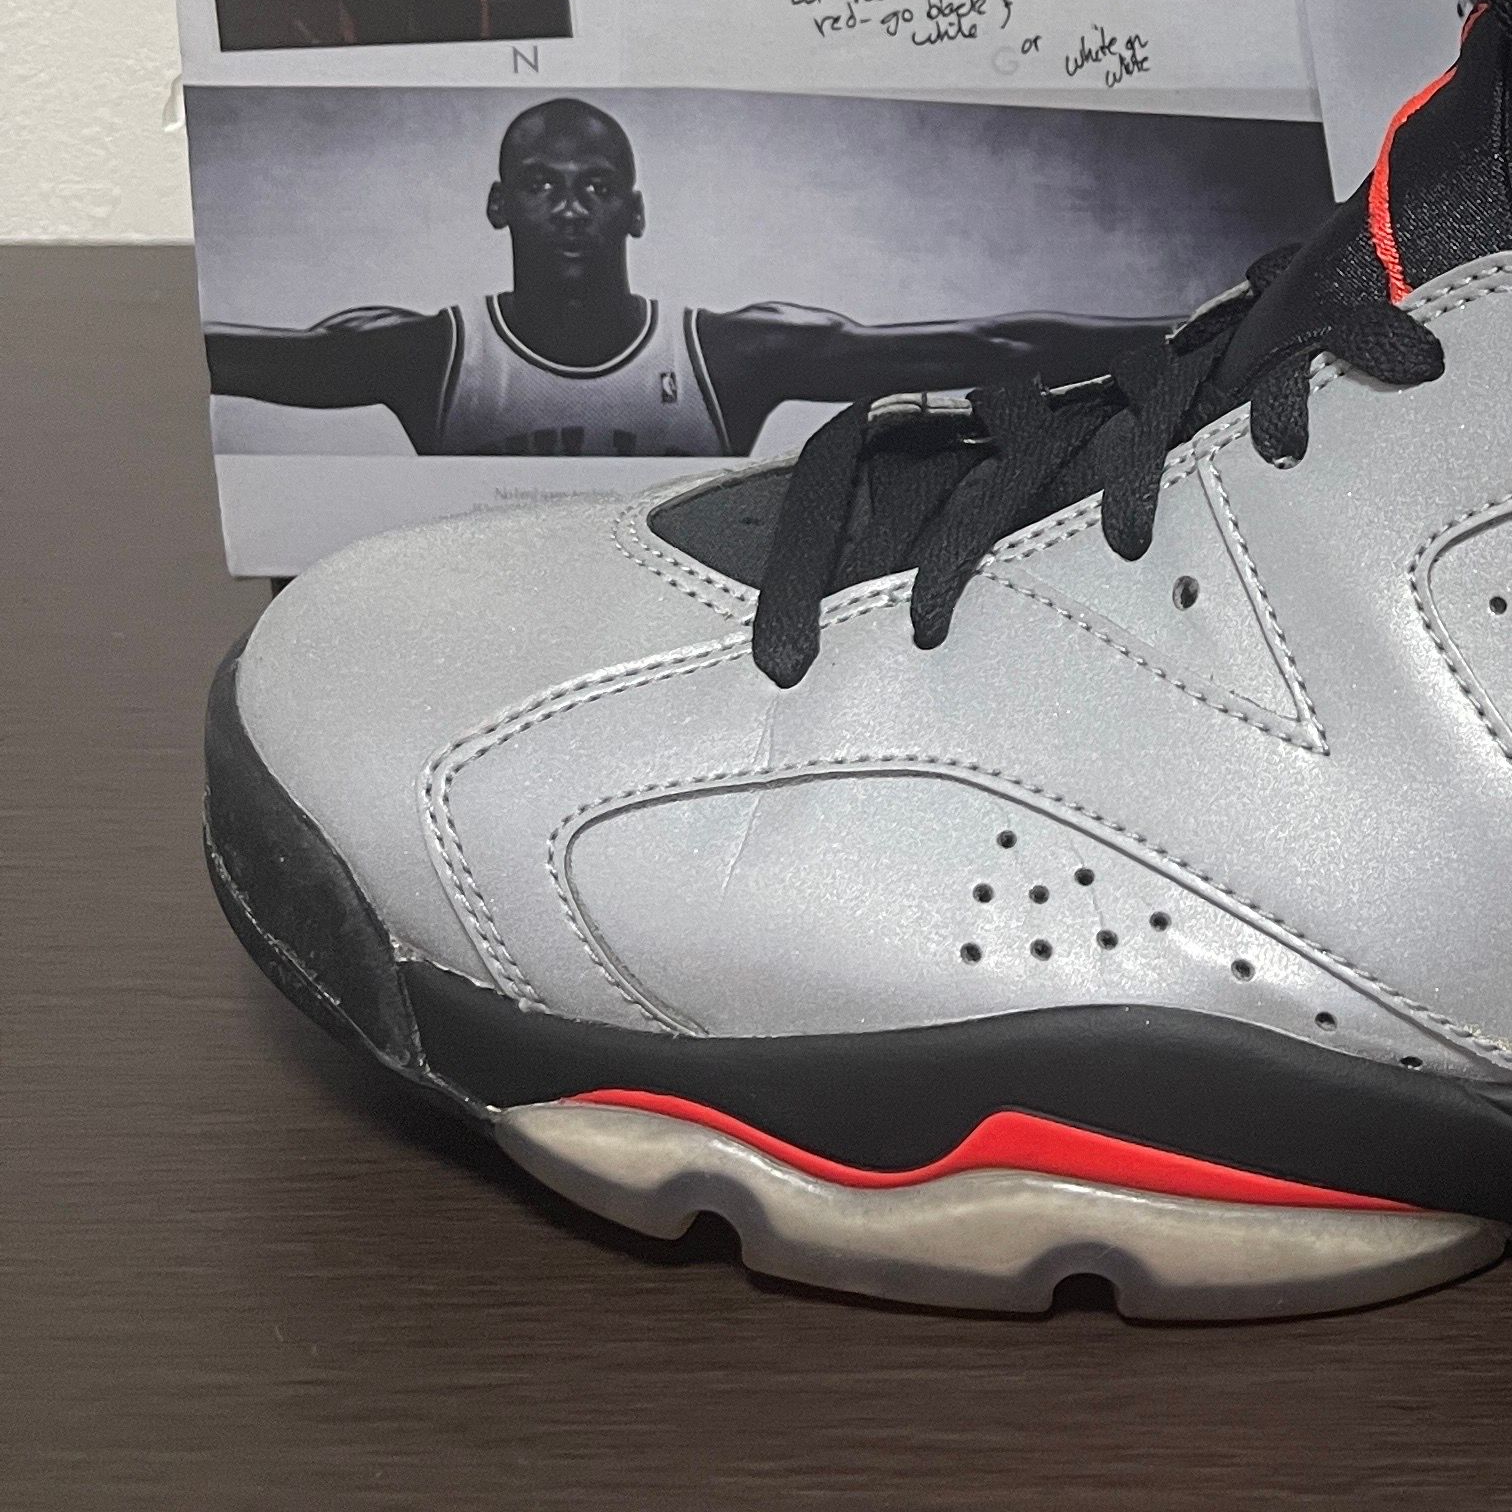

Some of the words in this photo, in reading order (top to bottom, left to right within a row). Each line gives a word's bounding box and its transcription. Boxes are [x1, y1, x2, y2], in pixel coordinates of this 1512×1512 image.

[512, 45, 539, 73] N
[1021, 35, 1042, 54] or
[1065, 24, 1118, 76] white
